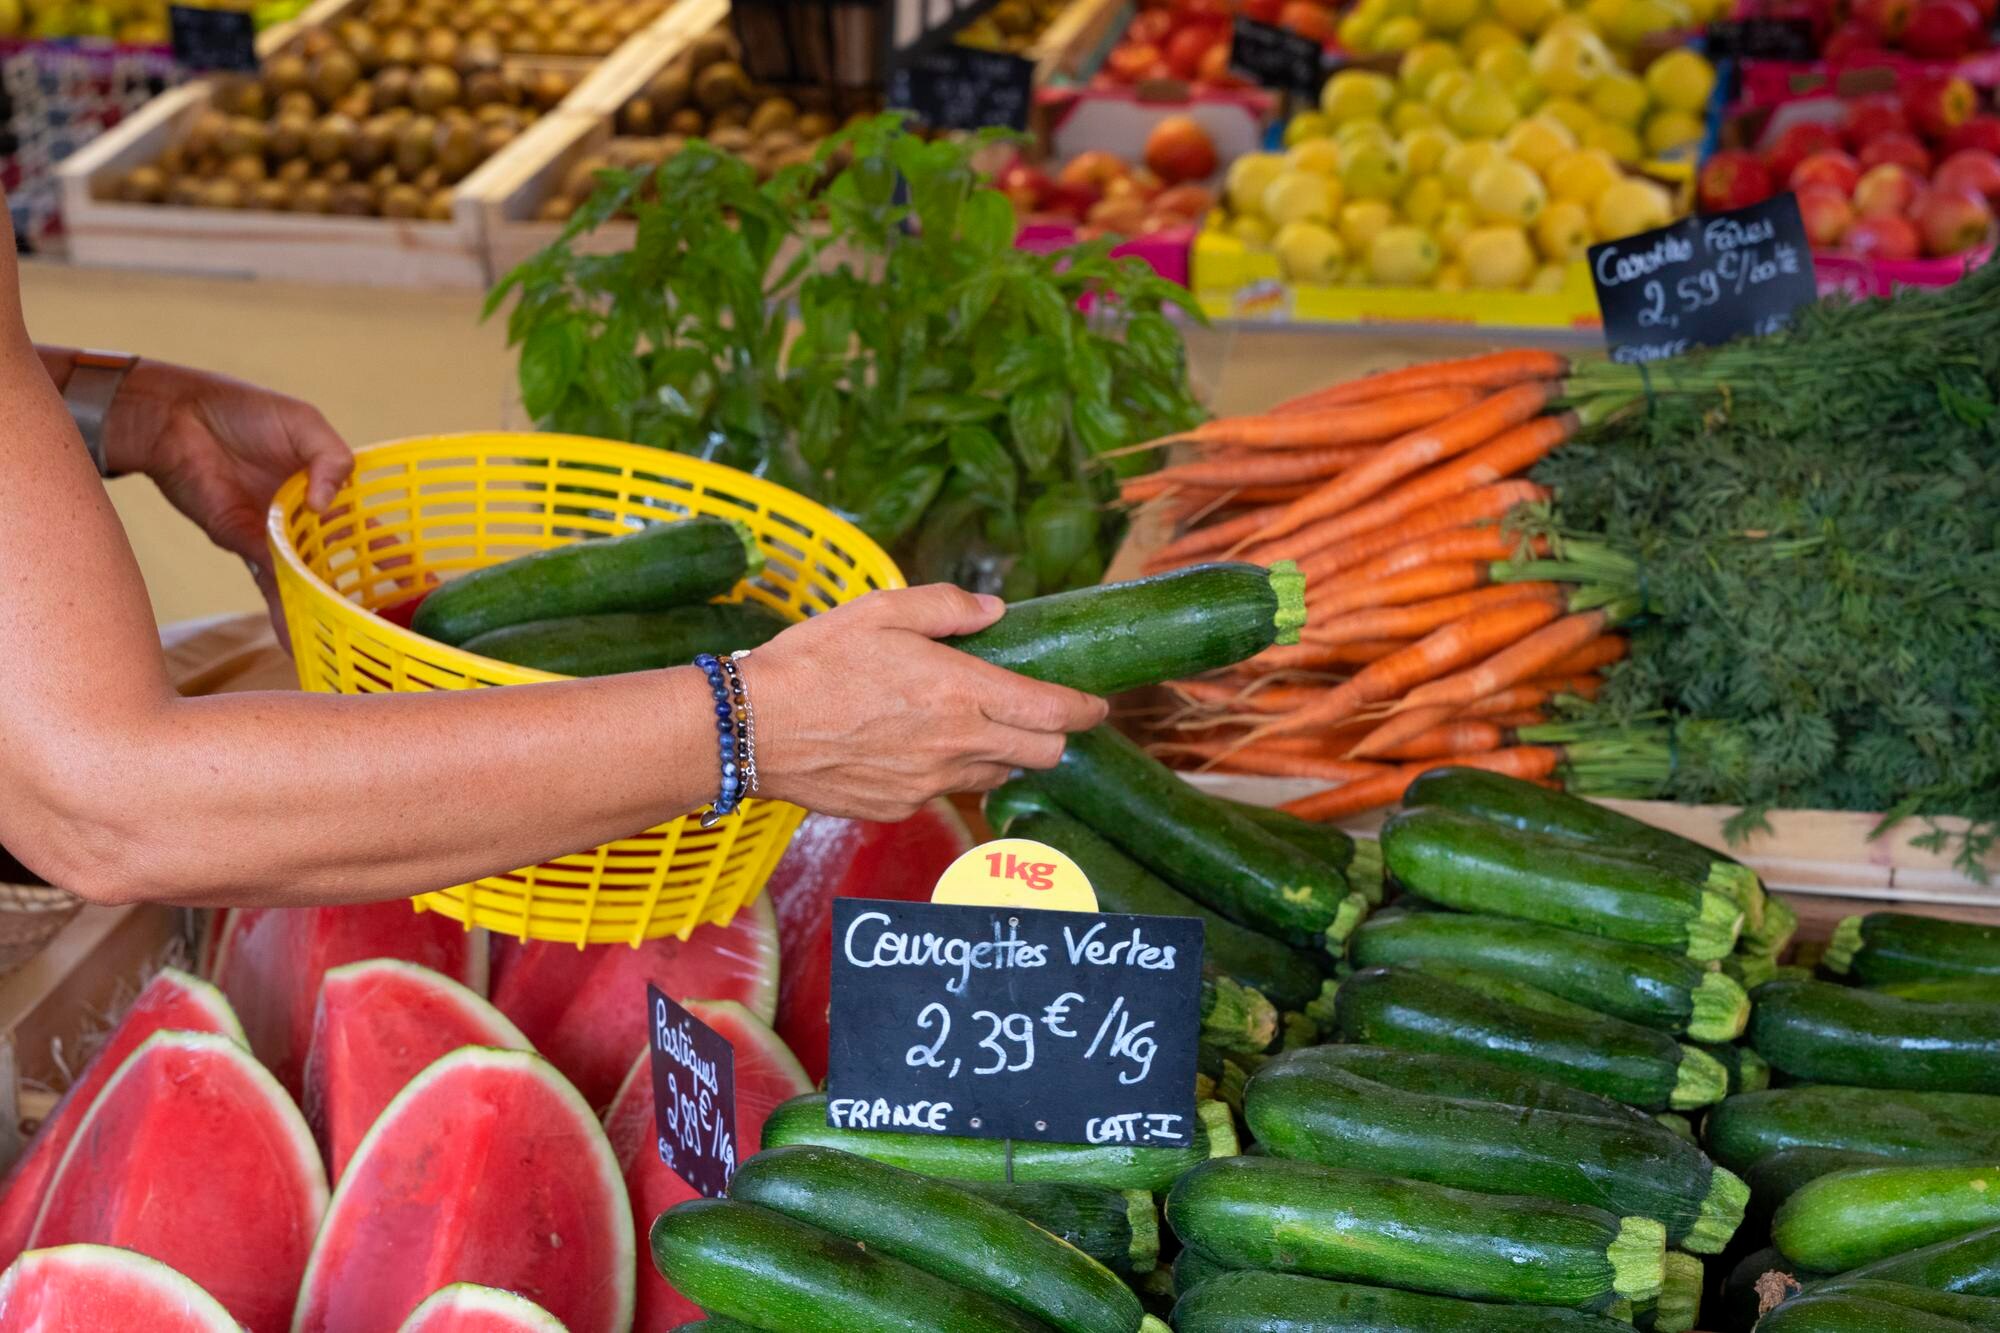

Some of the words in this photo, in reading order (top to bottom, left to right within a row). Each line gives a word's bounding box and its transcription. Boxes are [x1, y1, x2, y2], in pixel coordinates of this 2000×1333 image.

[985, 852, 1057, 891] 1kg
[843, 911, 1049, 997] Courgettes
[1063, 920, 1177, 971] Vertes
[830, 1098, 953, 1132] FRANCE
